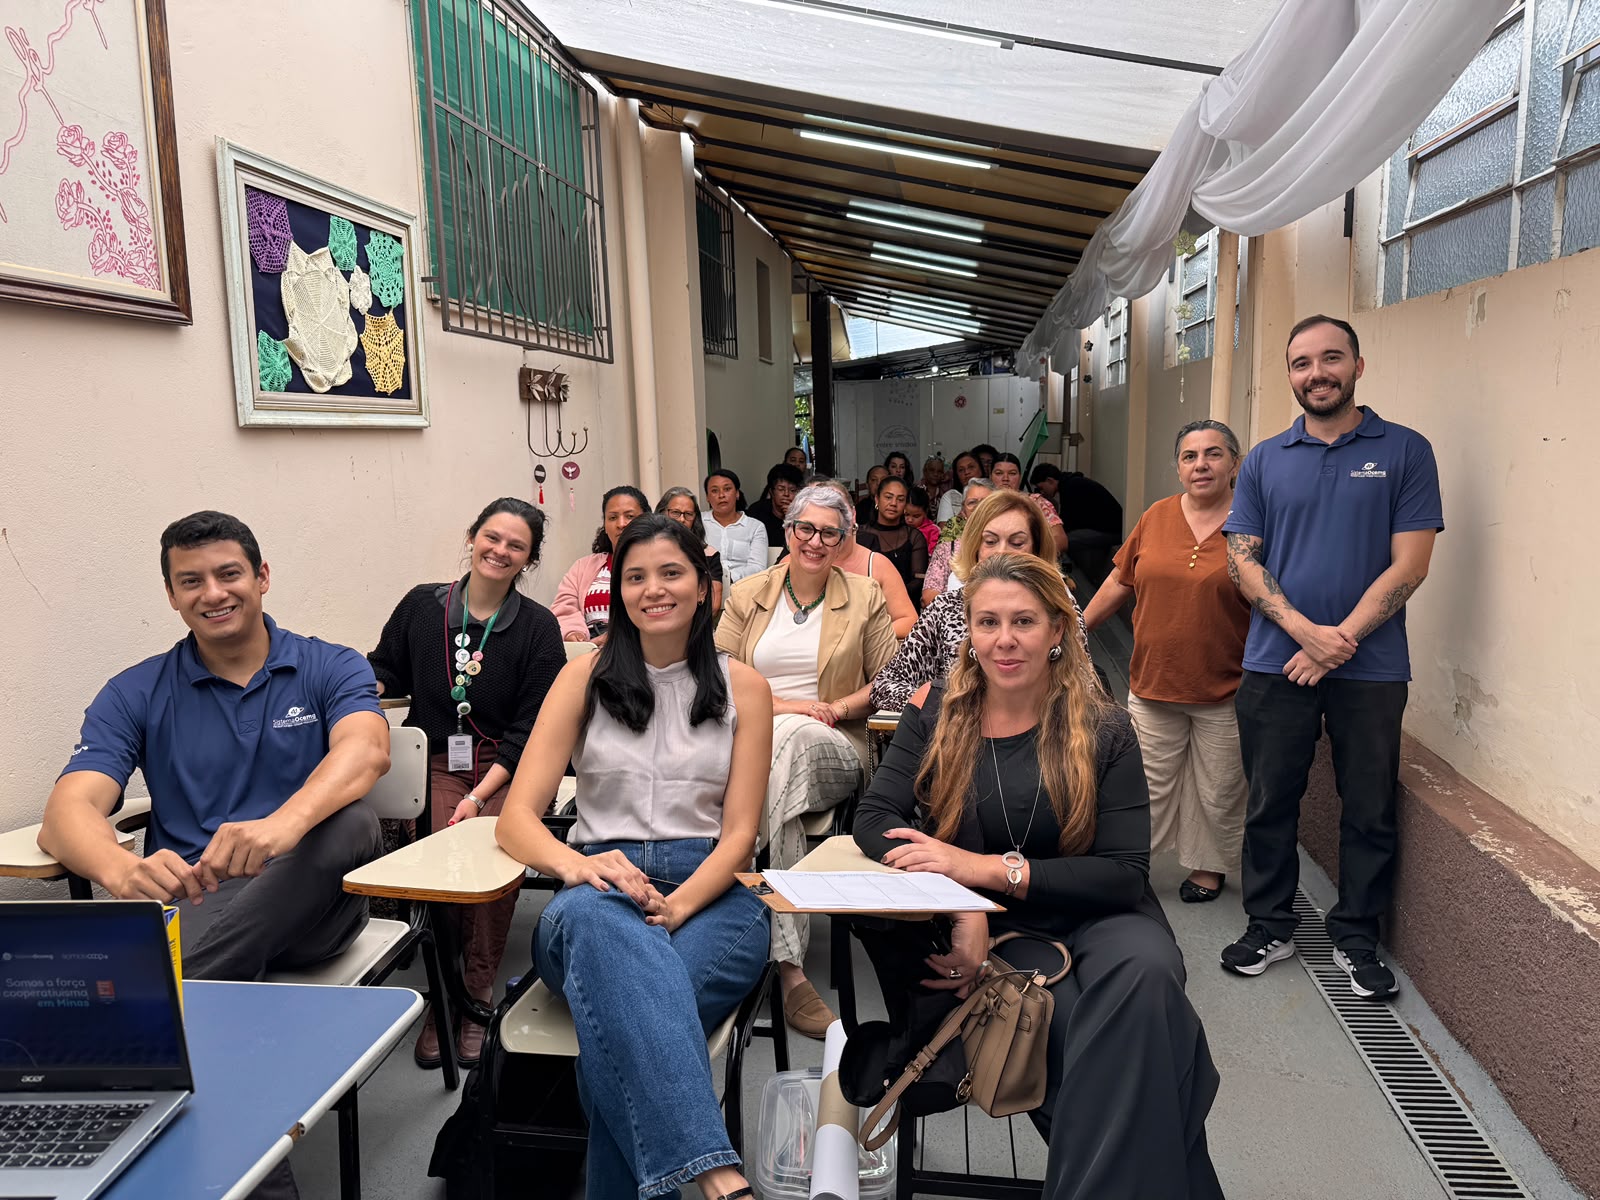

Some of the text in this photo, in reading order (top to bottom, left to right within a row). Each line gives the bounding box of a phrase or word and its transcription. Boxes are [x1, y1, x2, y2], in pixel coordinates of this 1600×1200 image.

[5, 978, 44, 988] Somos
[56, 978, 86, 989] força
[37, 999, 90, 1008] em Minas
[21, 1075, 45, 1083] acer
